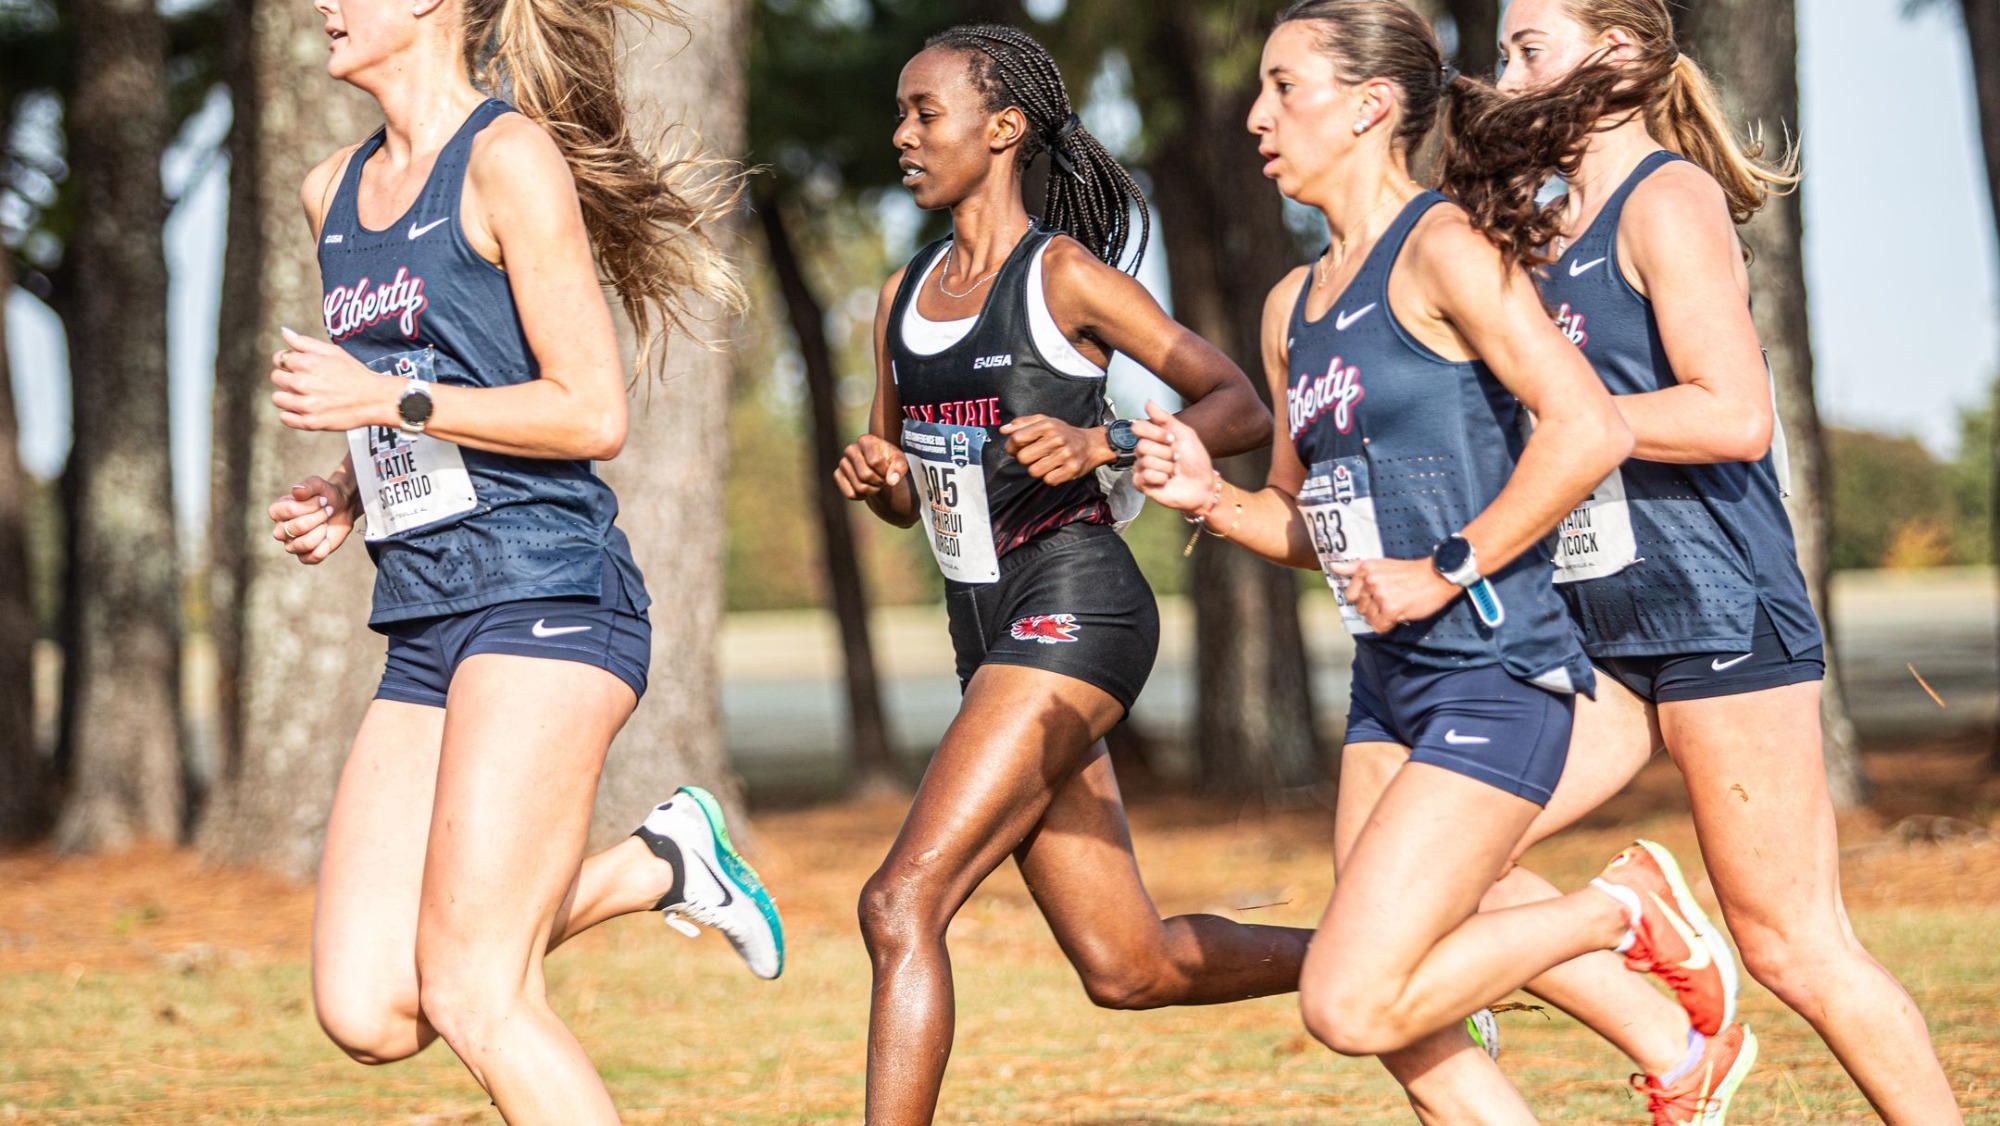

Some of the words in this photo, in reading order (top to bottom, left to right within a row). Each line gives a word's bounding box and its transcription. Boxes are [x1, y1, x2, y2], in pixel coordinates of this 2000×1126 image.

[324, 266, 429, 342] Liberty
[939, 397, 1002, 427] STATE
[1286, 356, 1365, 442] iberty
[377, 451, 417, 481] KATIE
